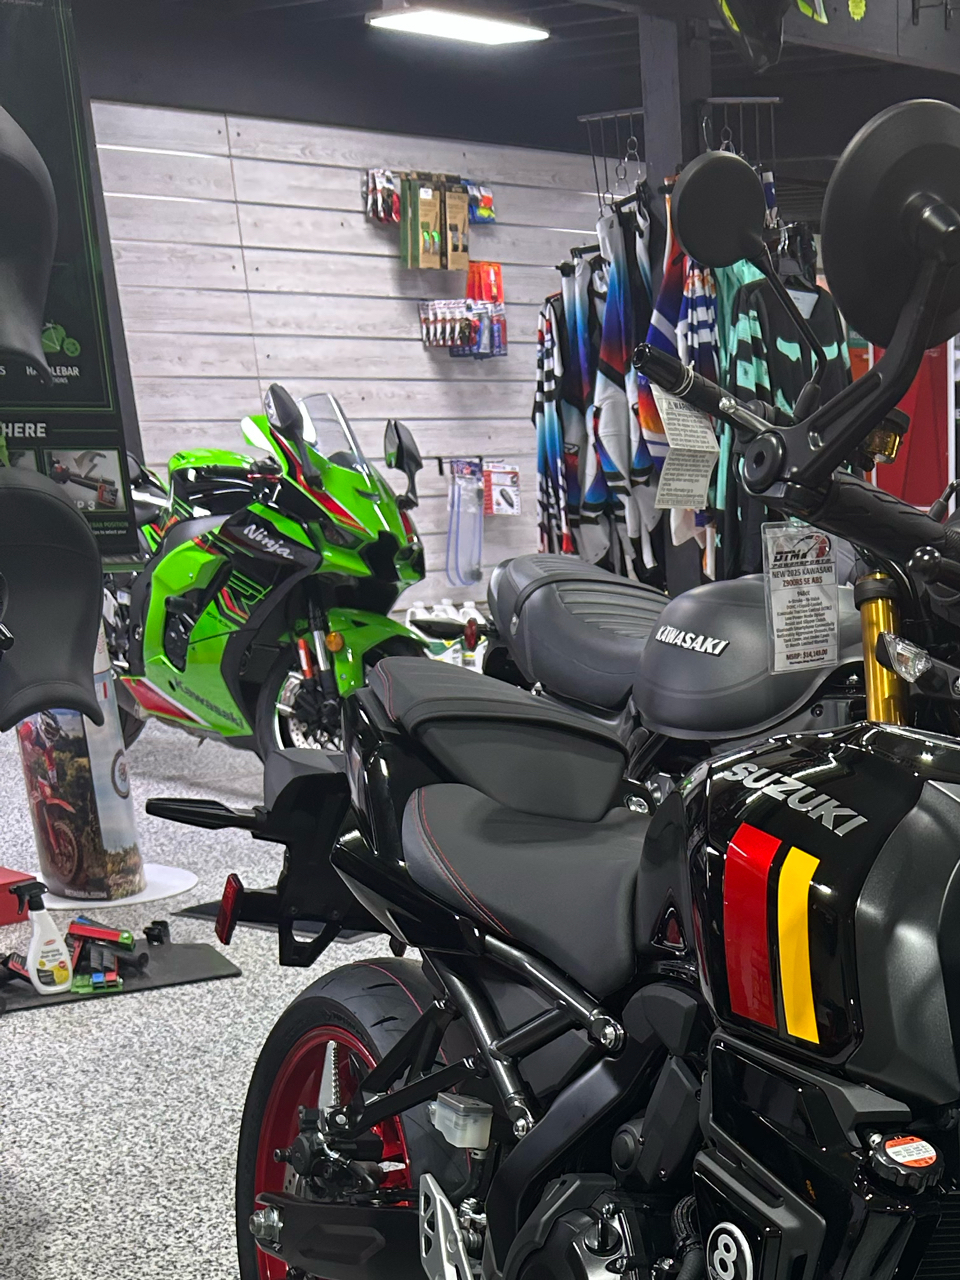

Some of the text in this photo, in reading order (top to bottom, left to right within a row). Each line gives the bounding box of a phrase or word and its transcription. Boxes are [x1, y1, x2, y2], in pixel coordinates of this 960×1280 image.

[26, 366, 80, 376] HLEBAR
[1, 423, 47, 438] HERE
[243, 523, 295, 560] Ninja
[771, 565, 833, 579] NEW 2025 KAWASAKI
[655, 624, 729, 655] KAWASAKI
[173, 676, 245, 728] Kawasaki
[722, 762, 868, 837] SUZUKI
